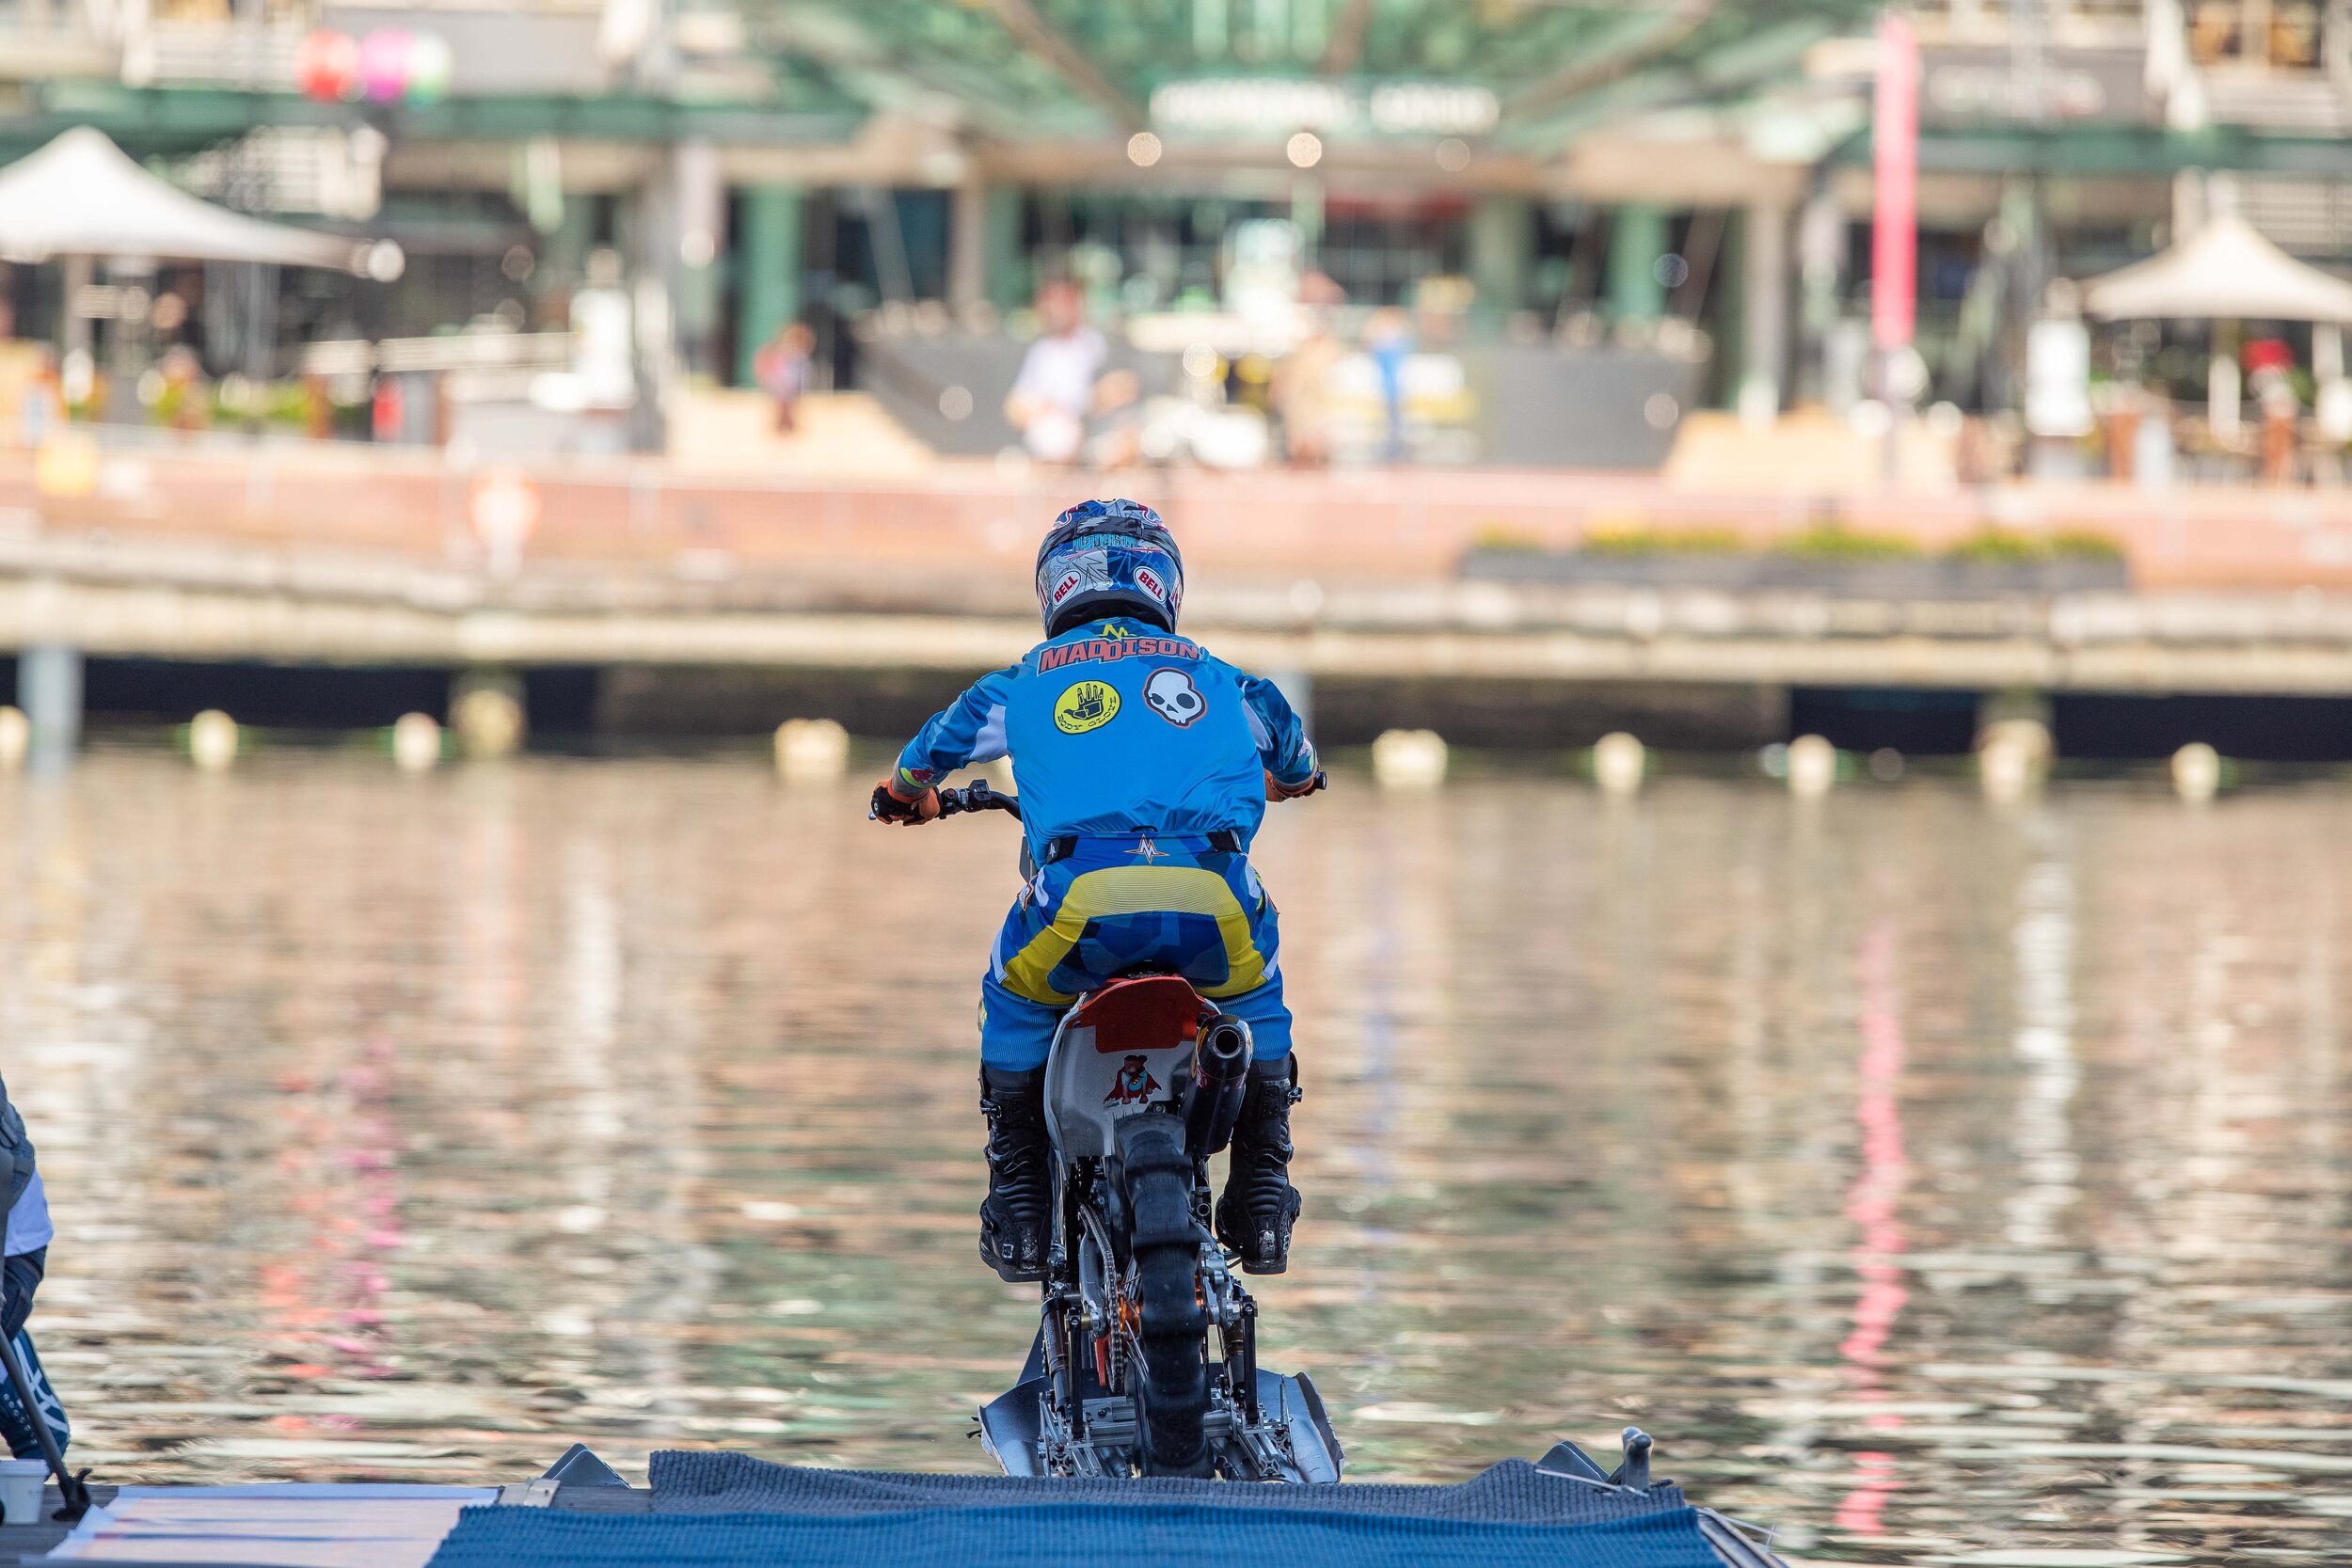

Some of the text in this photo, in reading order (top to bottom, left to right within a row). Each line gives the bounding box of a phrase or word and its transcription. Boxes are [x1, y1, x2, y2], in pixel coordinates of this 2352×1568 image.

[1054, 576, 1079, 603] BELL
[1138, 571, 1163, 600] BELL
[1038, 638, 1200, 674] MADDISON
[1057, 696, 1117, 730] BODY GLOVE
